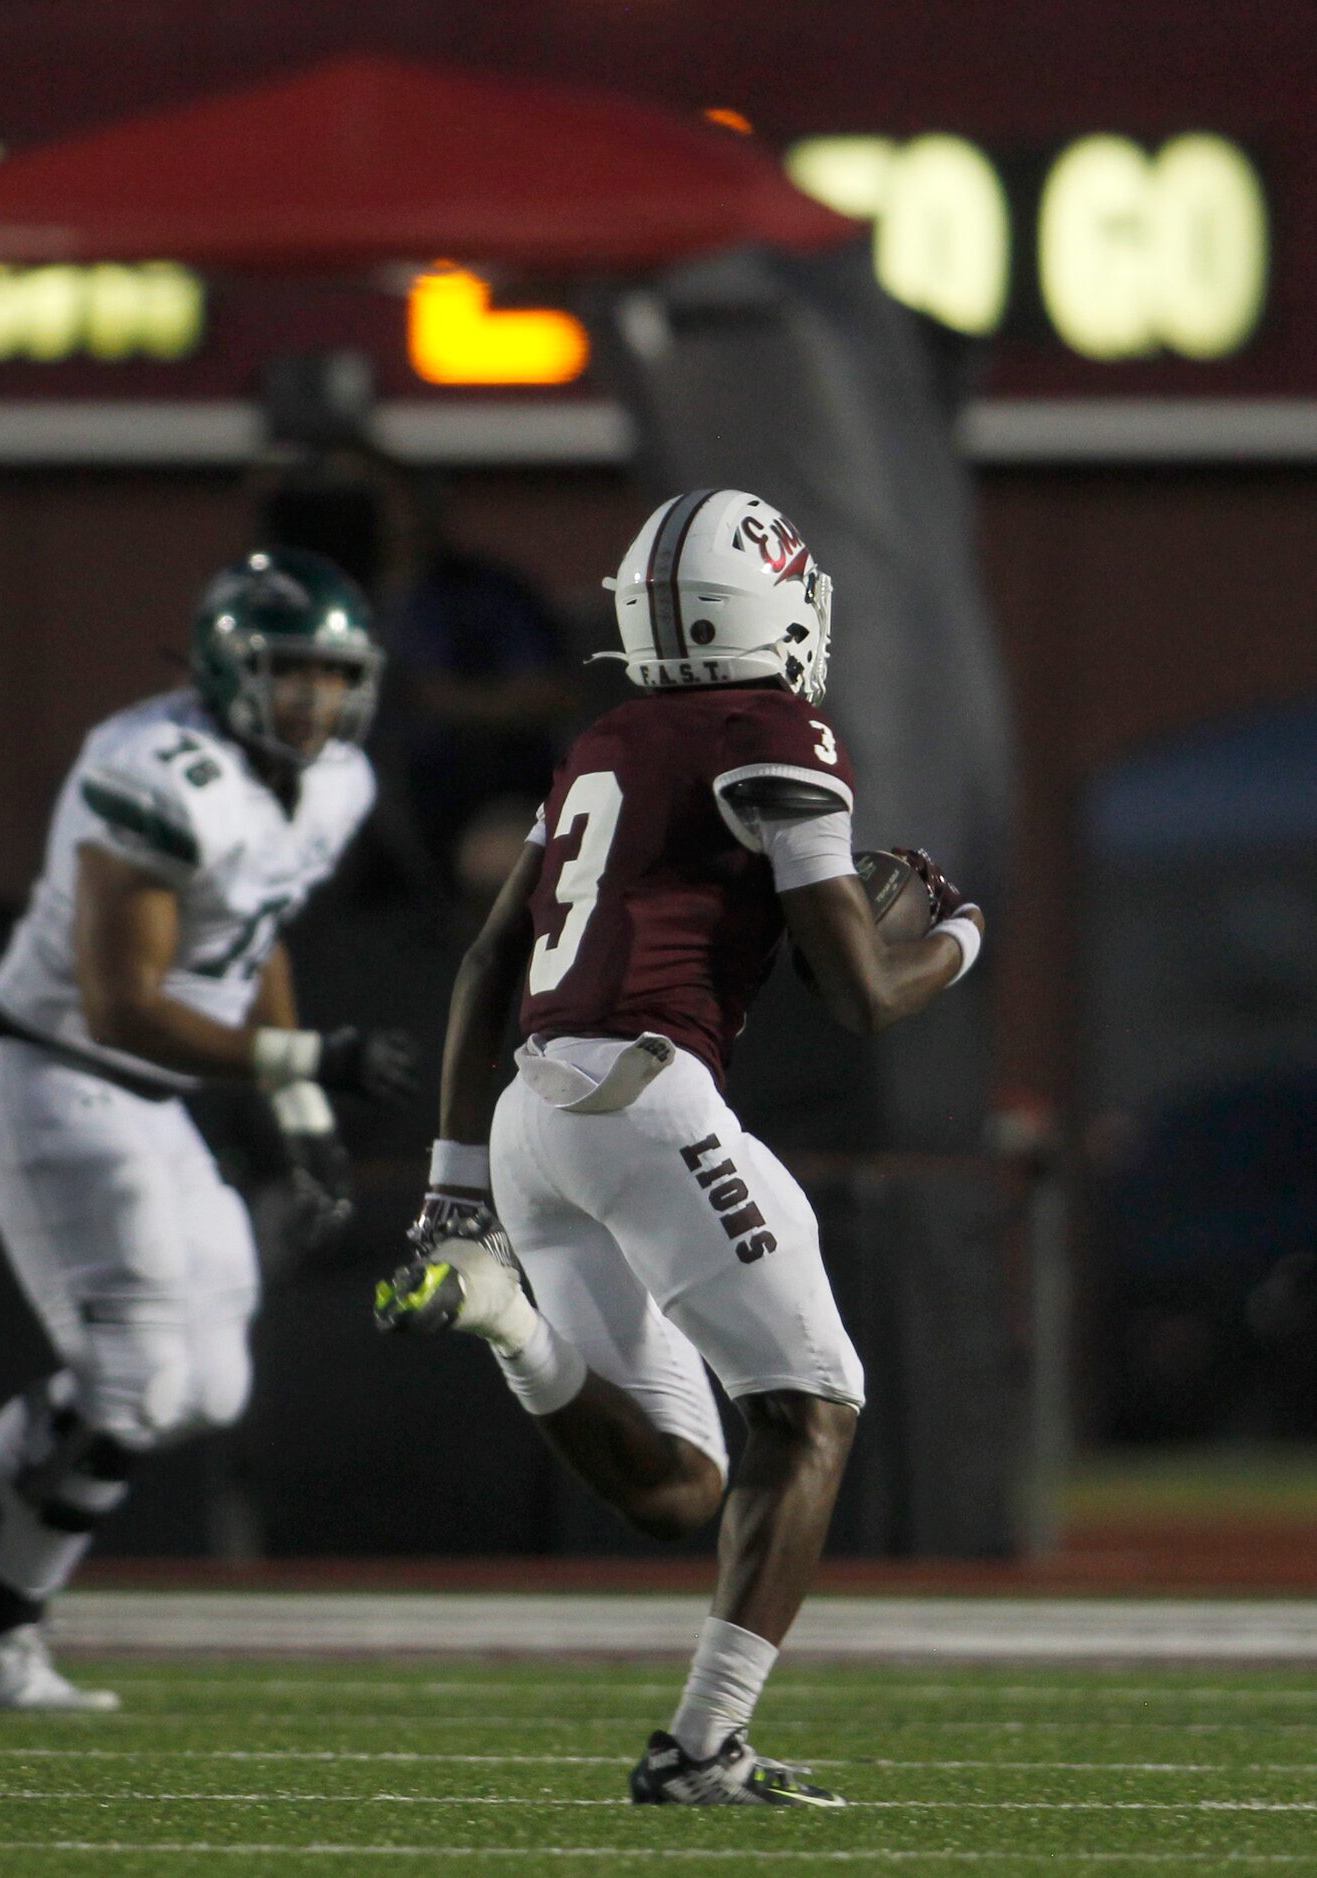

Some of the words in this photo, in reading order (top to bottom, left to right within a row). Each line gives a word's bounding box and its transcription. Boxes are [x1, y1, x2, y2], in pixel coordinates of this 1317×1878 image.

[808, 719, 838, 766] 3
[529, 771, 624, 997] 3
[680, 1133, 778, 1265] LIONS
